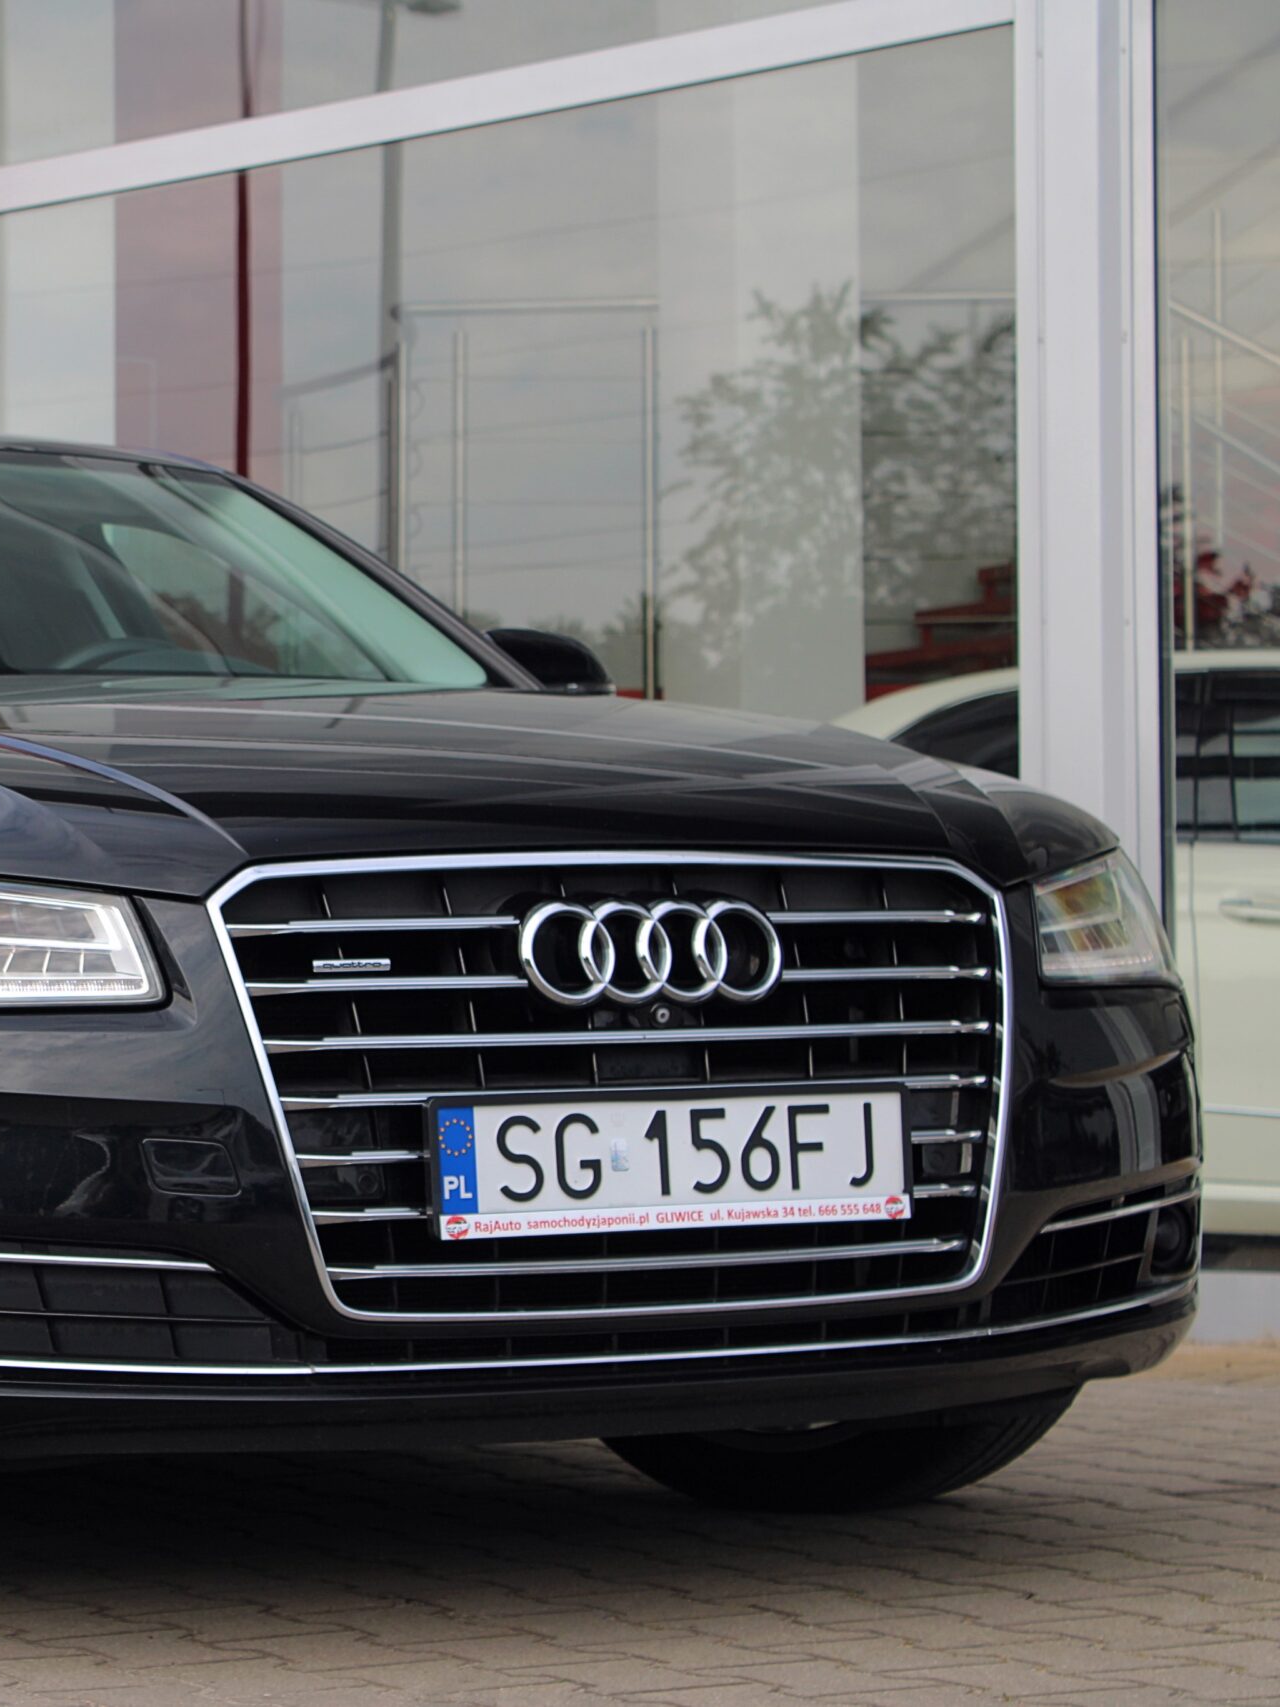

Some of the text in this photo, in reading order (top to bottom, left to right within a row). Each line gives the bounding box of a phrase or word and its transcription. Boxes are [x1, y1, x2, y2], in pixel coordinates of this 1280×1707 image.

[496, 1102, 874, 1201] SG 156FJ
[443, 1175, 473, 1199] PL
[474, 1219, 522, 1233] RajAuto
[527, 1212, 650, 1230] samochodyzjaponii.pl
[656, 1210, 704, 1223] GLIWICE
[710, 1209, 724, 1221] ul.
[727, 1207, 779, 1222] Kujawska
[782, 1206, 795, 1217] 34
[798, 1205, 815, 1217] tel.
[818, 1204, 838, 1216] 666
[841, 1203, 860, 1215] 555
[862, 1202, 882, 1214] 648
